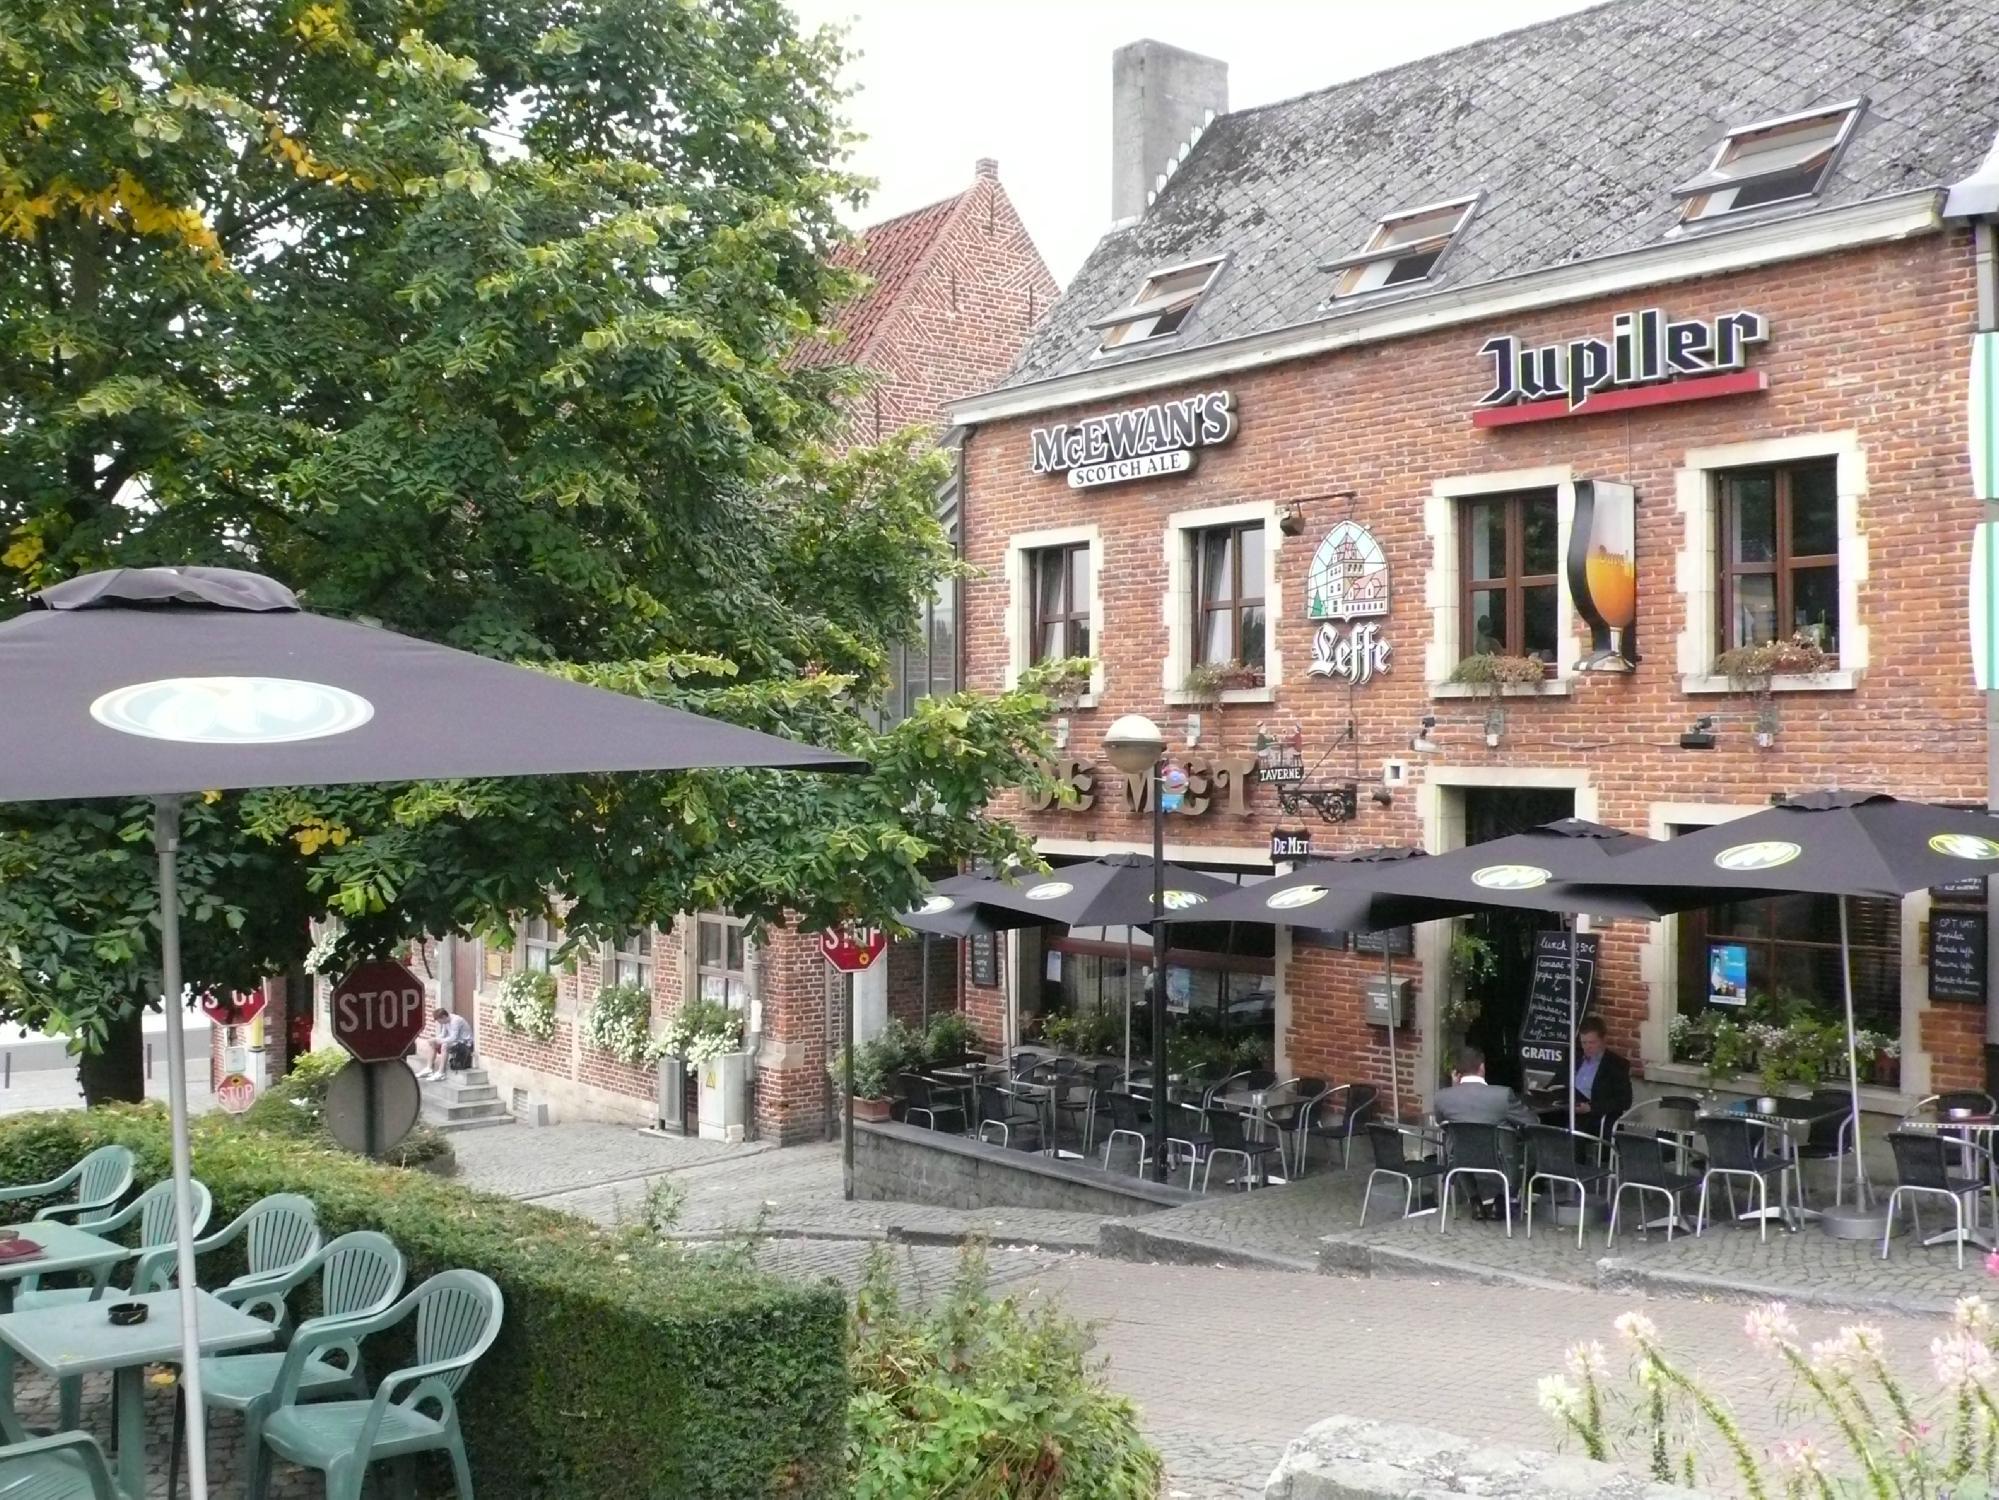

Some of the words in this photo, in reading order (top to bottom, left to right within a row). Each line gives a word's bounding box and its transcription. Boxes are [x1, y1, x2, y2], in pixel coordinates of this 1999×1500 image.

[1475, 308, 1767, 411] Jupiler
[1075, 460, 1141, 485] SCOTCH
[1147, 453, 1181, 473] ALE
[1307, 621, 1393, 685] Leffe
[1260, 768, 1301, 782] TAVERNE
[339, 988, 419, 1033] STOP
[1521, 1046, 1562, 1061] GRATIS
[217, 1083, 254, 1103] STOP
